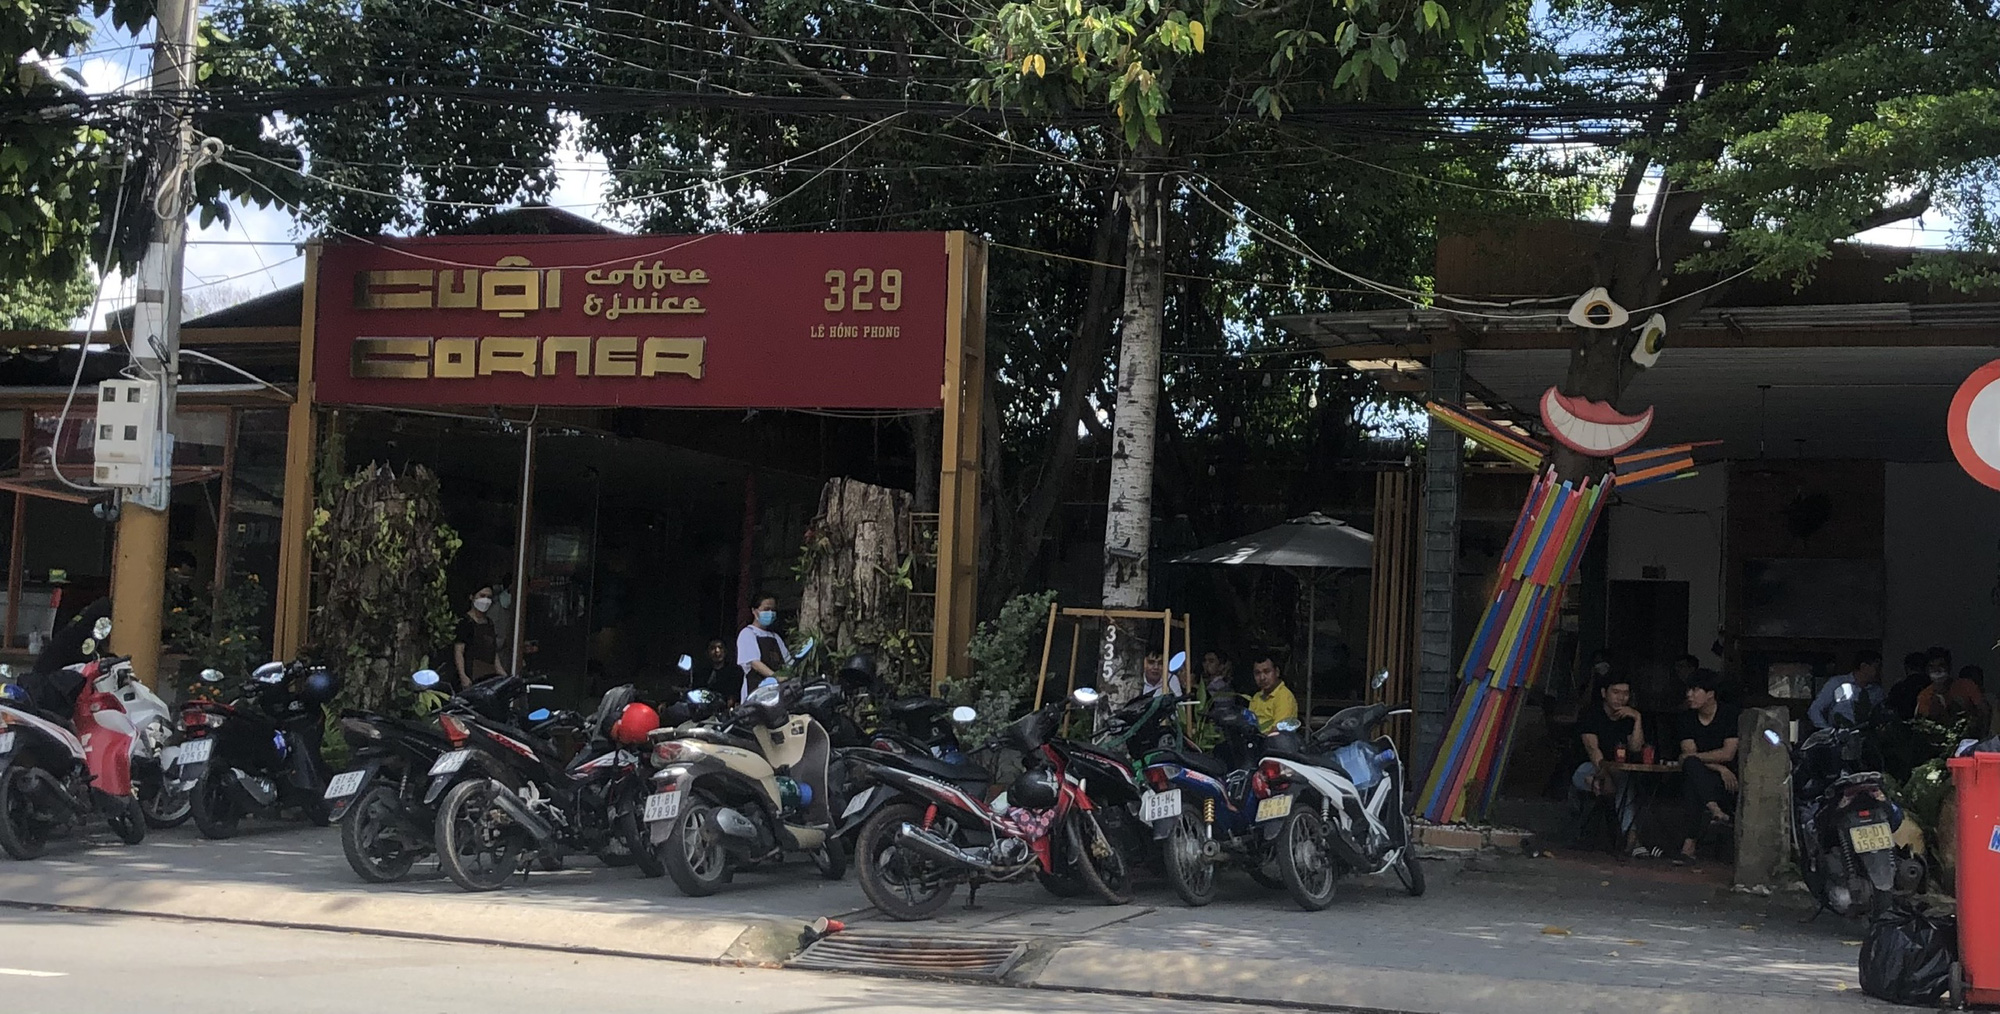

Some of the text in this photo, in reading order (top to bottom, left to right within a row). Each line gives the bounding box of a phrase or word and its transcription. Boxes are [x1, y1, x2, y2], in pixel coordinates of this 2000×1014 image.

[585, 260, 710, 290] coffee
[824, 268, 903, 311] 329
[863, 325, 901, 338] PHONG
[350, 335, 706, 380] CORNER
